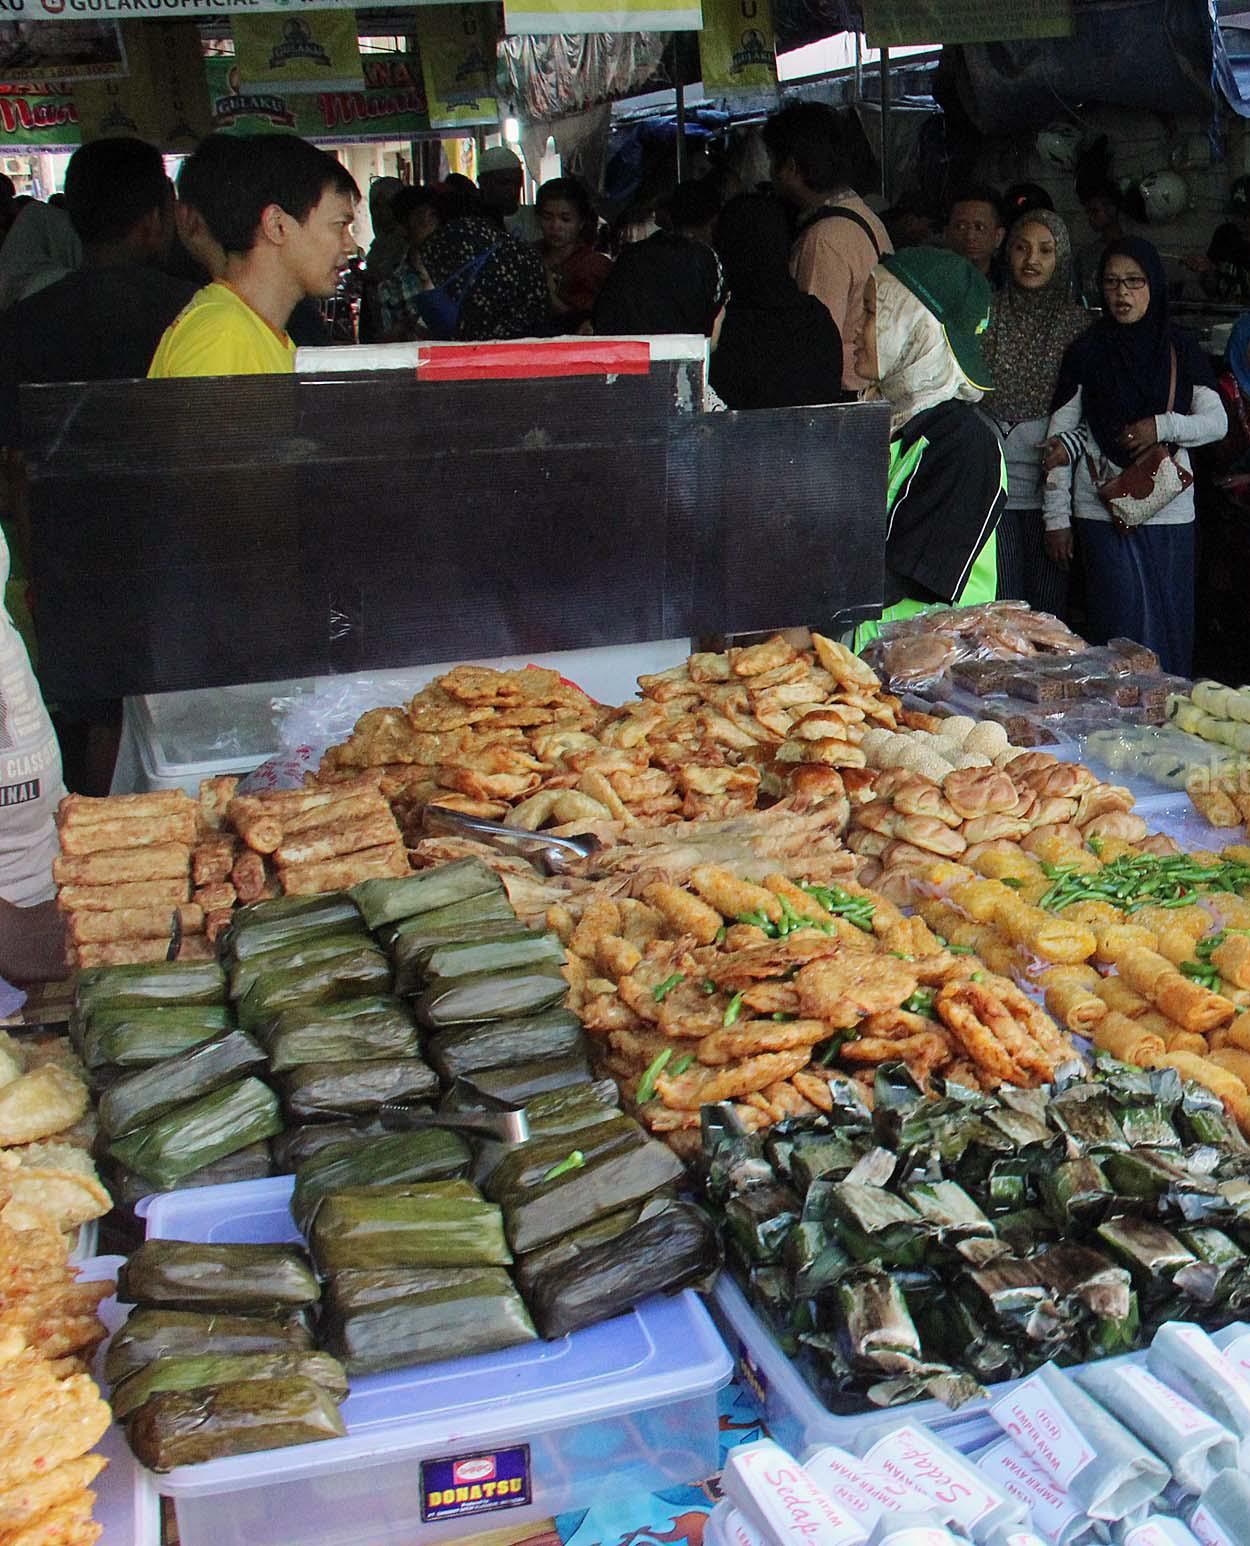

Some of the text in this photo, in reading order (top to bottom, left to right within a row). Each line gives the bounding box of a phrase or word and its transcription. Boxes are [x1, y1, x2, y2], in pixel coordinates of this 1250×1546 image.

[1011, 1404, 1062, 1471] LEMPER AYAM
[428, 1478, 522, 1507] DONATSU
[829, 1458, 860, 1485] AYAM
[902, 1447, 972, 1504] Sedap
[1000, 1455, 1064, 1510] LEMPER AYAM
[764, 1468, 818, 1538] Sedap
